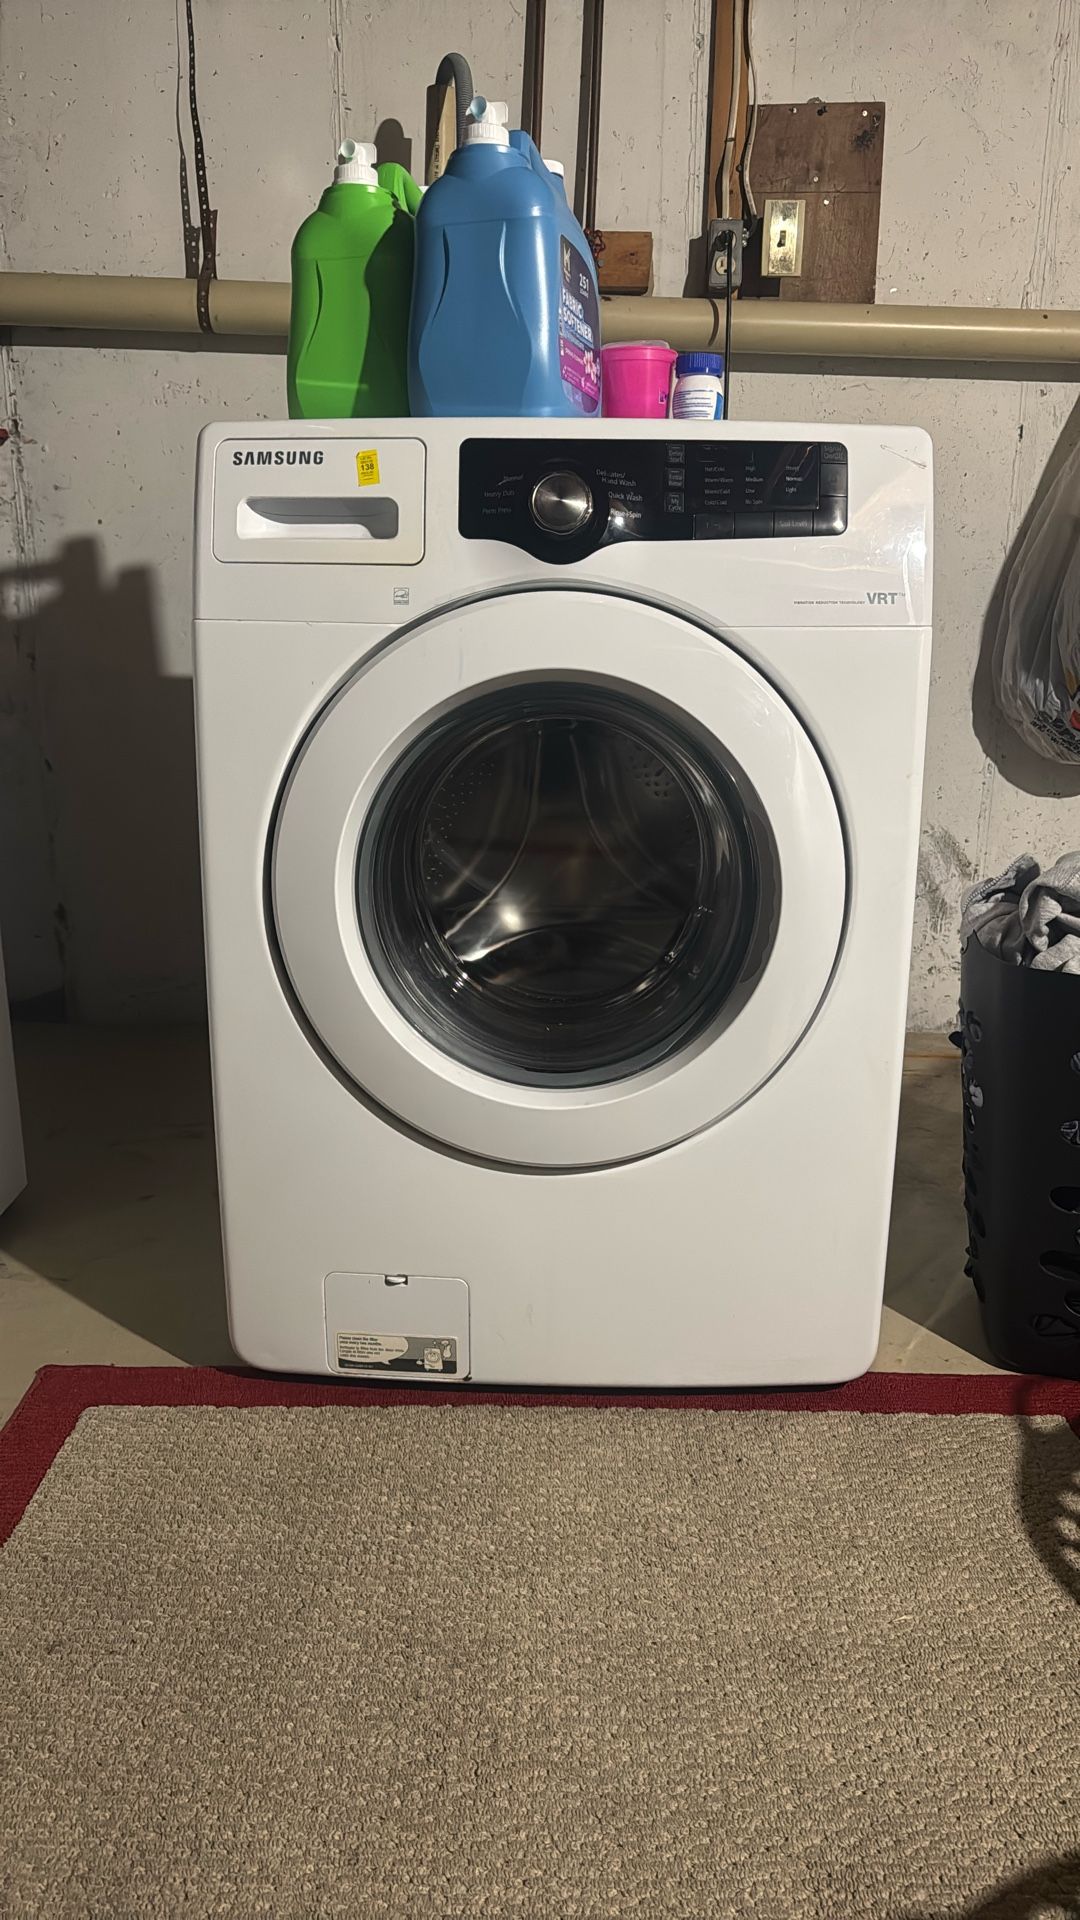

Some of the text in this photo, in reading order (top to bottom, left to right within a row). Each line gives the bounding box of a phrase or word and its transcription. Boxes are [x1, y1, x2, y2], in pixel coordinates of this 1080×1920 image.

[579, 272, 589, 292] 251
[562, 287, 584, 321] FABRIC
[563, 305, 594, 342] SOFTENER
[232, 450, 325, 466] SAMSUNG
[361, 462, 375, 472] 138
[608, 490, 643, 502] Quick Wash
[785, 486, 797, 494] Light
